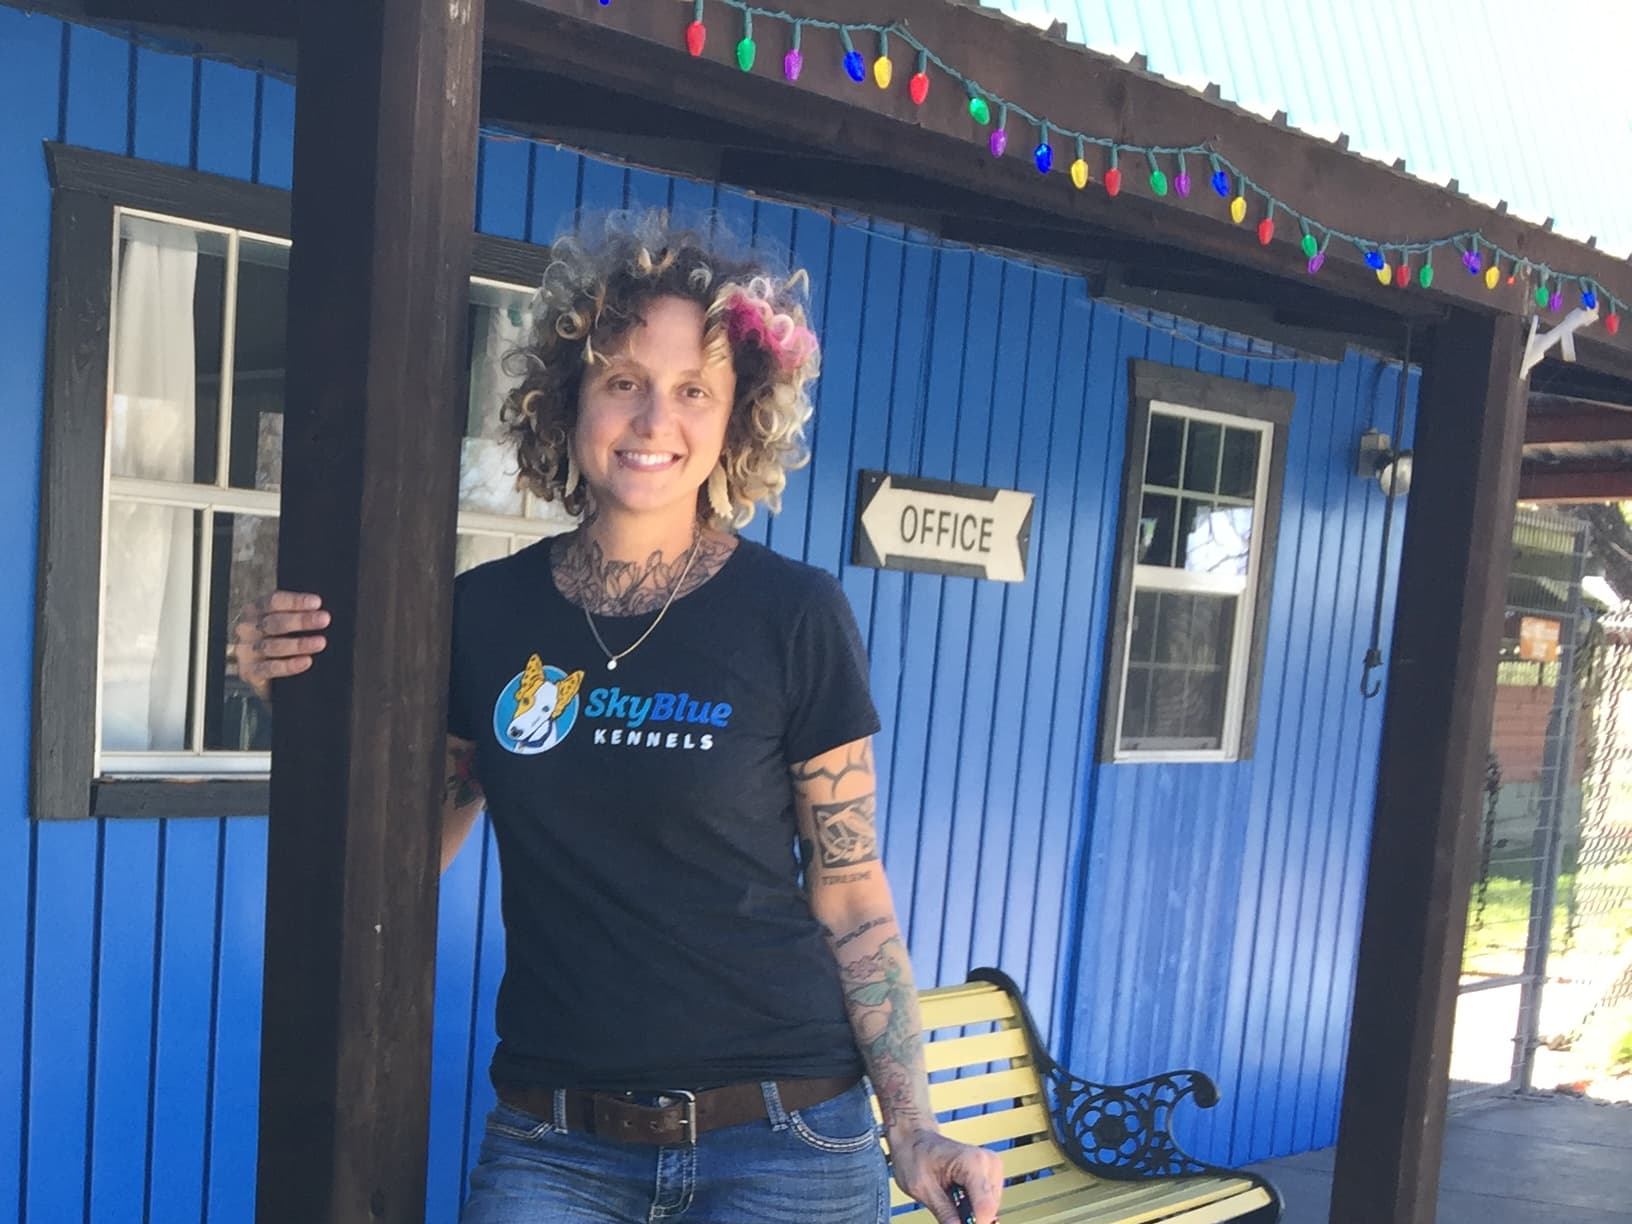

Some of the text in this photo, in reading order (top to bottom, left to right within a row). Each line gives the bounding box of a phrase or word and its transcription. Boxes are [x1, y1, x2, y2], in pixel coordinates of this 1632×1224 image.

[900, 504, 994, 553] OFFICE
[584, 687, 733, 728] SkyBlue
[594, 728, 714, 750] KENNELS
